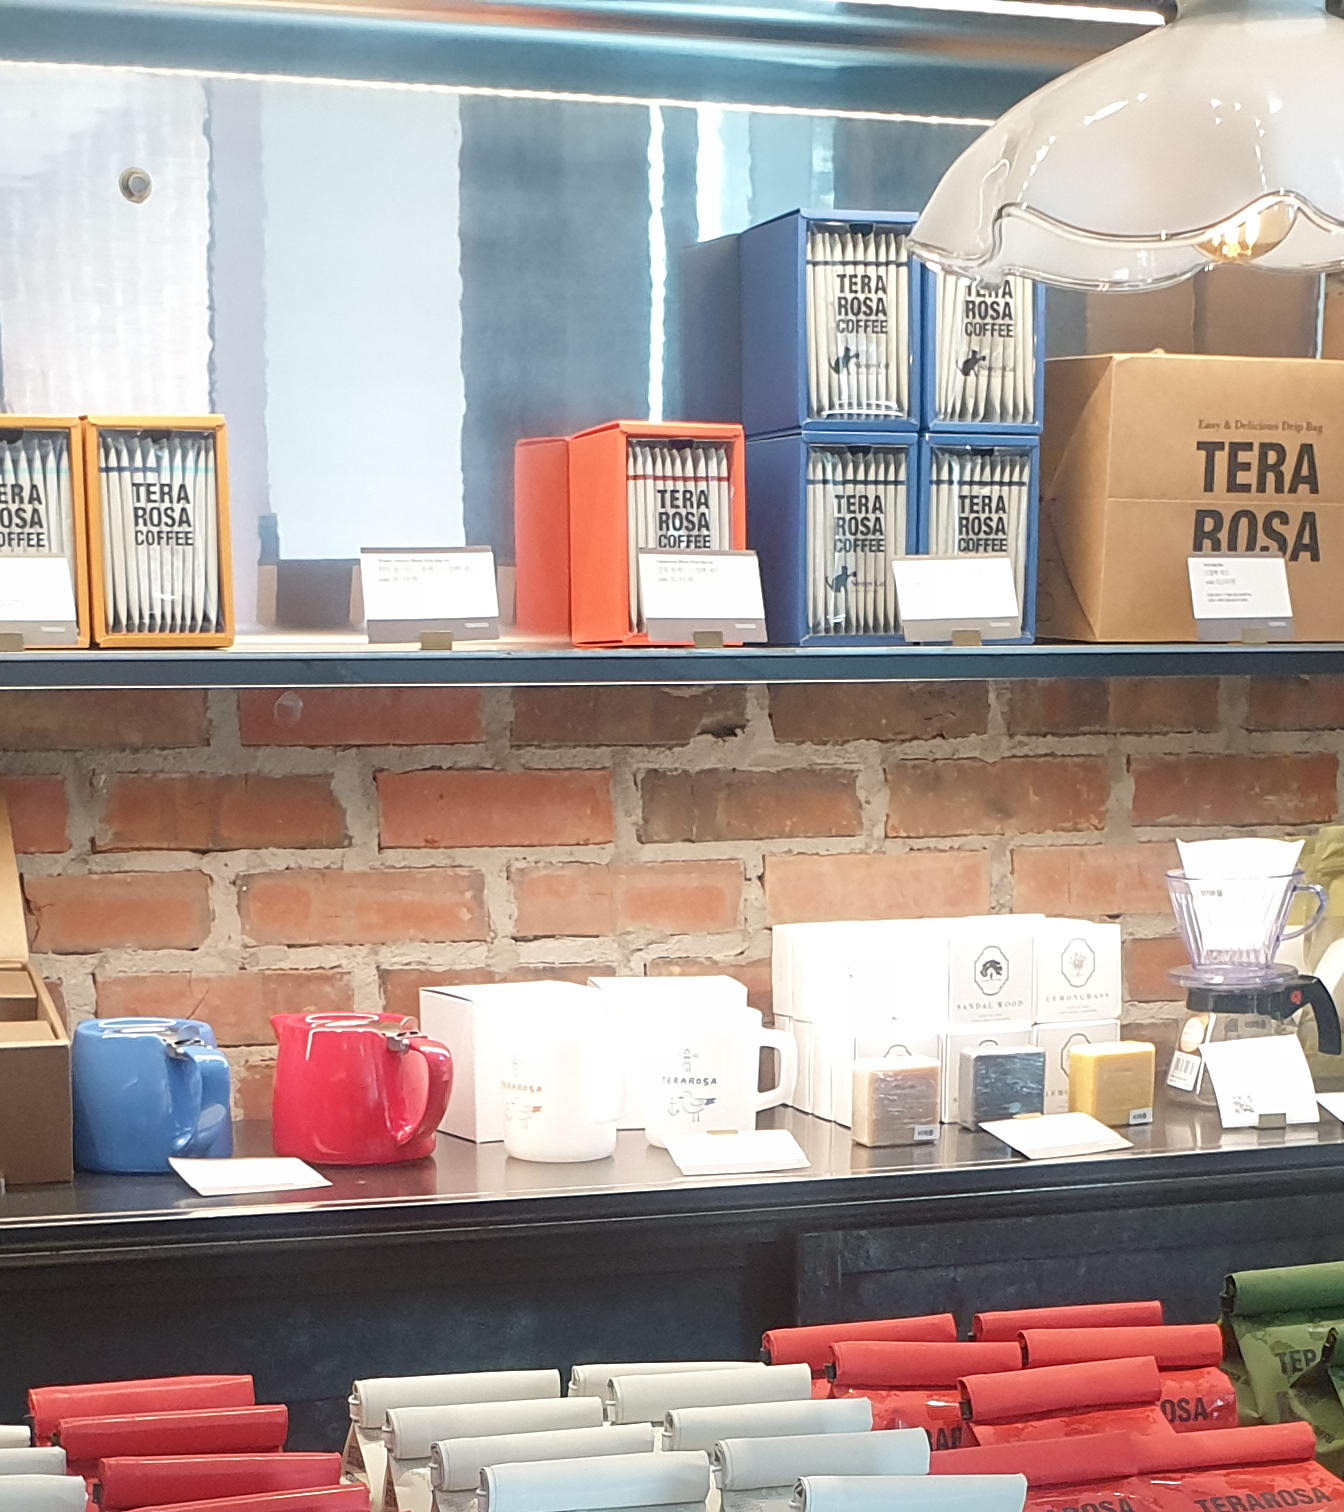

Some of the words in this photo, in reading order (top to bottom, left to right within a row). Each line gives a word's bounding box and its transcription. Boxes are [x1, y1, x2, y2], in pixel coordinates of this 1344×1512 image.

[836, 274, 887, 294] TERA
[837, 297, 887, 316] ROSA
[965, 301, 1013, 320] ROSA
[837, 320, 888, 334] COFFEE
[965, 323, 1014, 337] COFFEE
[1235, 420, 1279, 431] Delicious
[1282, 421, 1303, 434] Drip
[1306, 422, 1323, 434] Bag
[1196, 442, 1319, 494] TERA
[131, 483, 190, 504] TERA
[656, 489, 709, 510] TERA
[834, 495, 884, 514] TERA
[958, 495, 1006, 514] TERA
[133, 507, 193, 528] ROSA
[657, 512, 710, 532] ROSA
[835, 517, 885, 536] ROSA
[958, 517, 1006, 536] ROSA
[134, 531, 194, 547] COFFEE
[658, 533, 711, 548] COFFEE
[834, 539, 885, 553] COFFEE
[958, 538, 1007, 552] COFFEE
[1192, 510, 1320, 563] ROSA
[957, 1001, 992, 1010] SANDAL
[998, 1000, 1024, 1008] WOOD
[662, 1076, 717, 1086] TERAROSA
